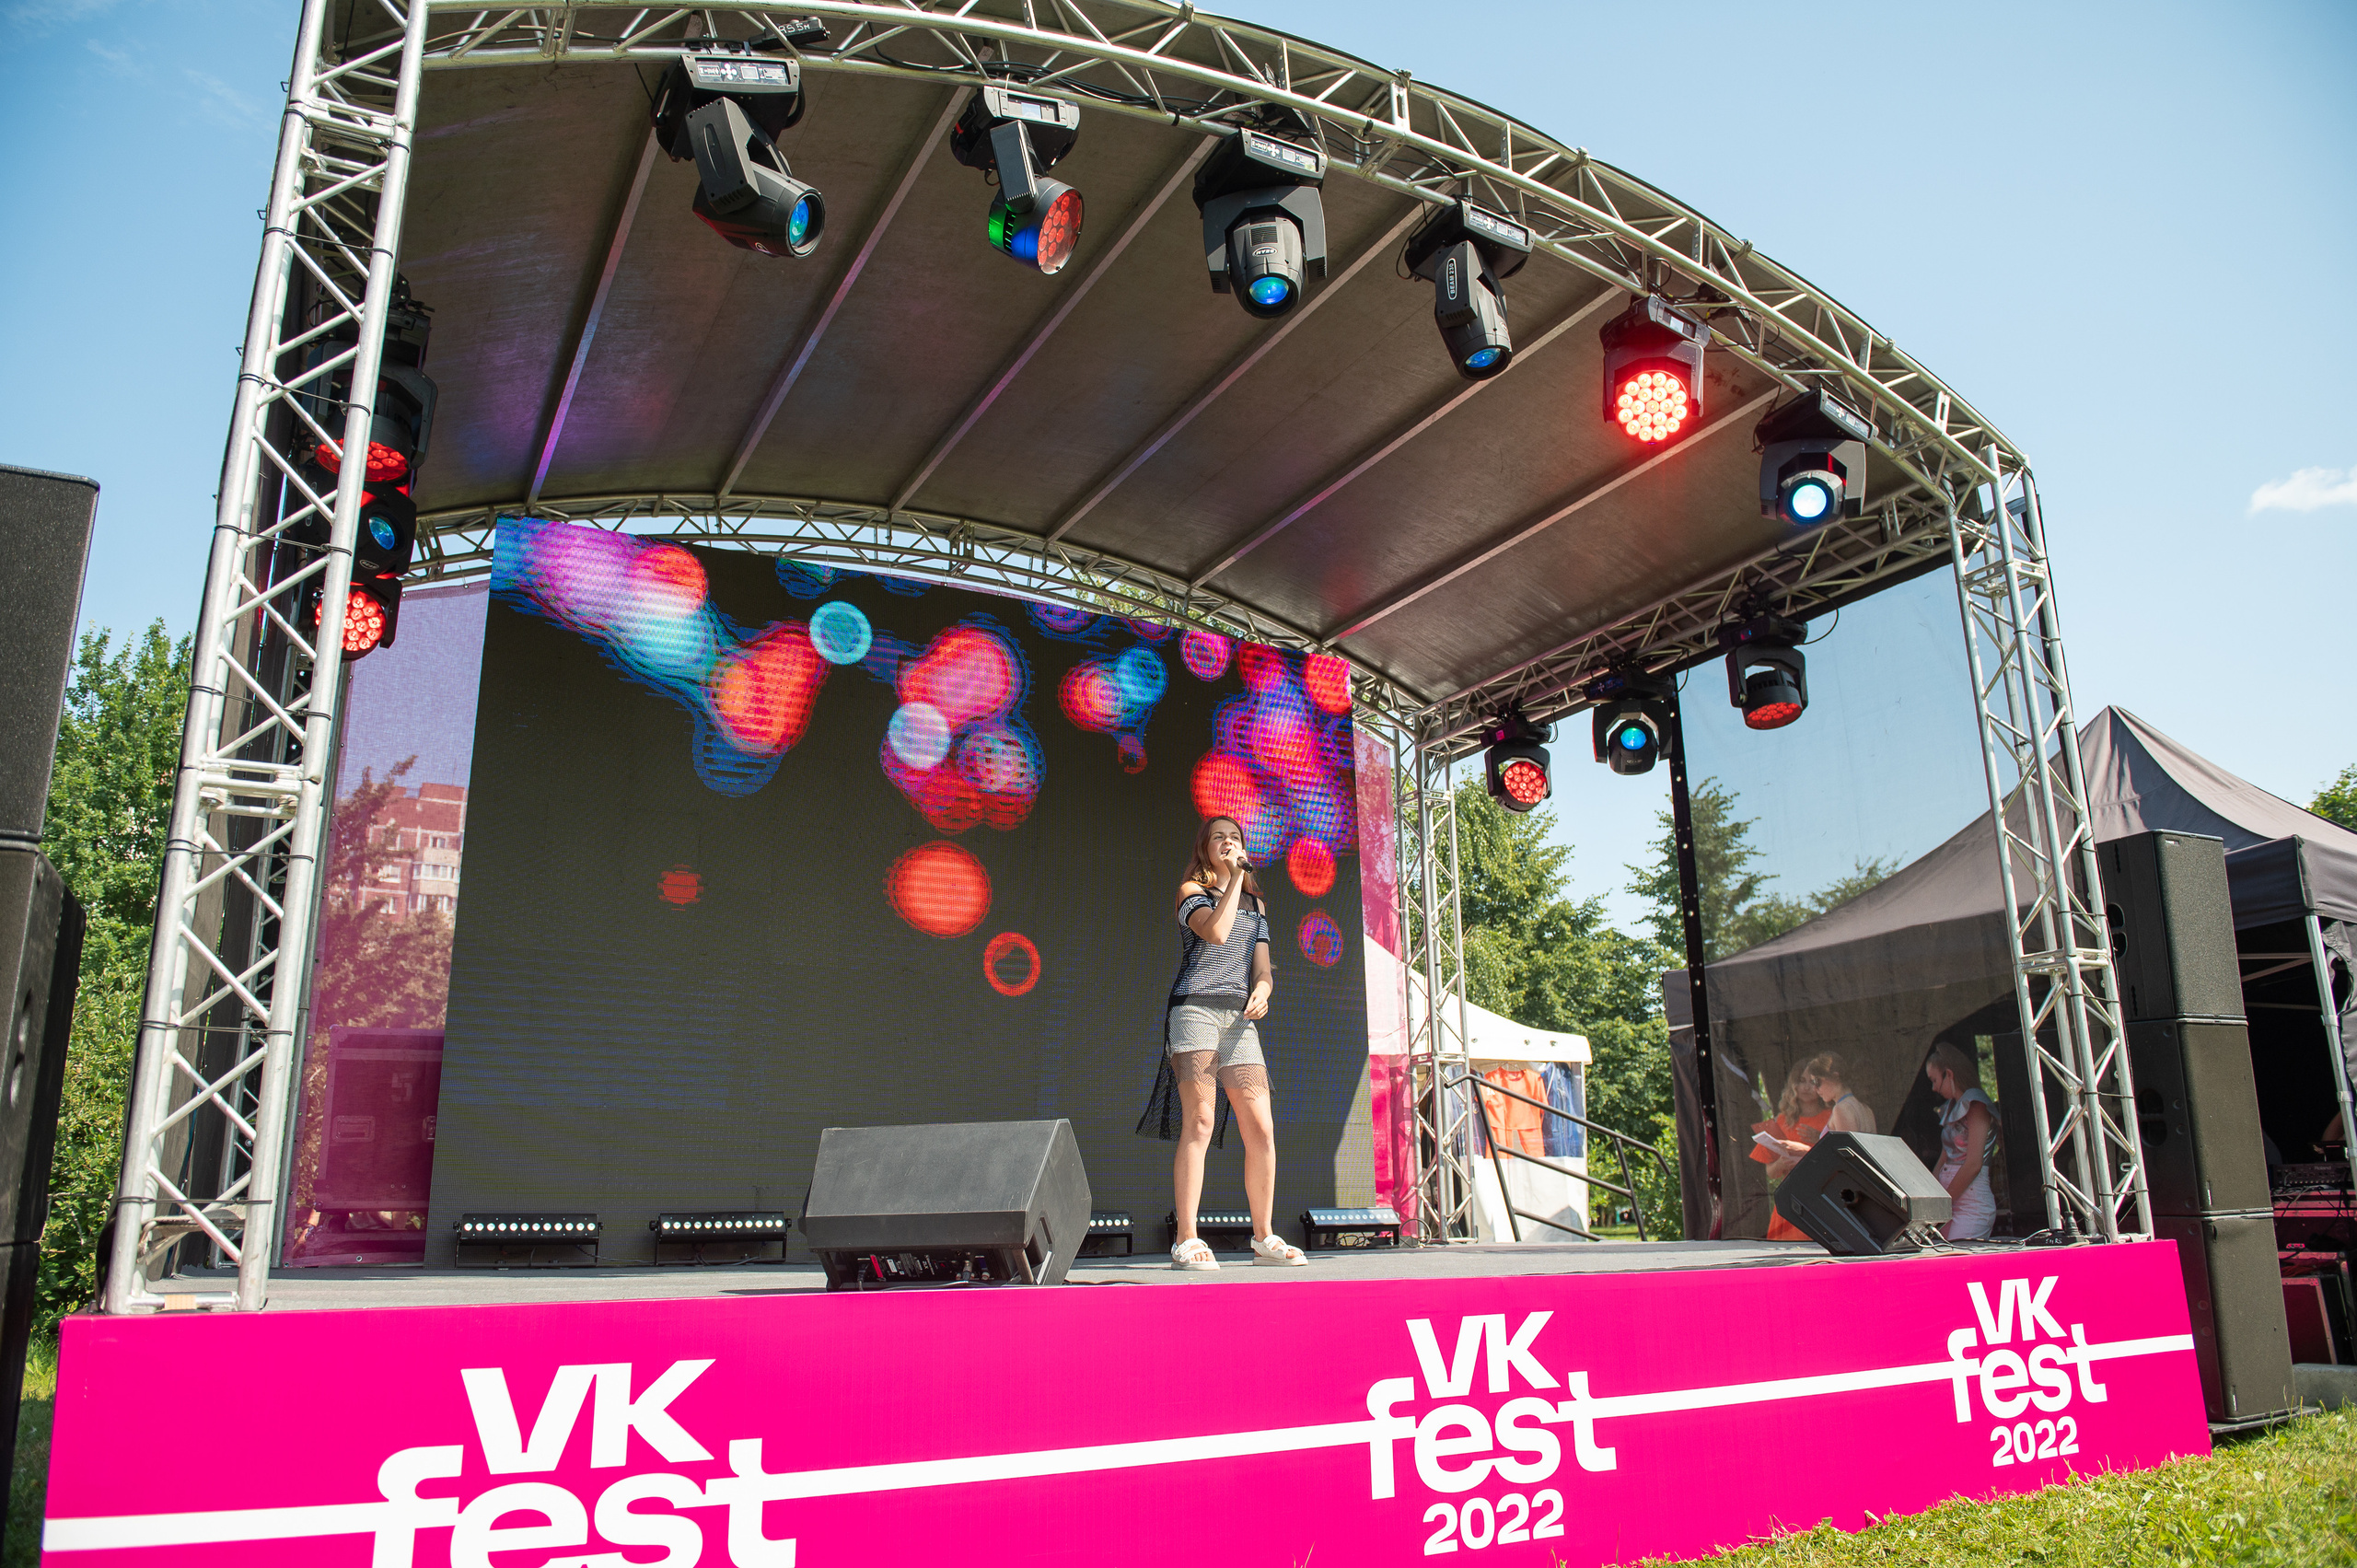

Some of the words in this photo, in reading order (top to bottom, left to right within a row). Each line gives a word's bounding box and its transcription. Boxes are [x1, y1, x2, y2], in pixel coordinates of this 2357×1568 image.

[1406, 1311, 1561, 1399] VK
[1967, 1276, 2067, 1344] VK
[461, 1359, 715, 1474] VK
[1947, 1323, 2107, 1423] fest
[1366, 1371, 1618, 1500] fest
[1991, 1416, 2079, 1467] 2022
[372, 1438, 796, 1568] fest
[1423, 1489, 1564, 1555] 2022
